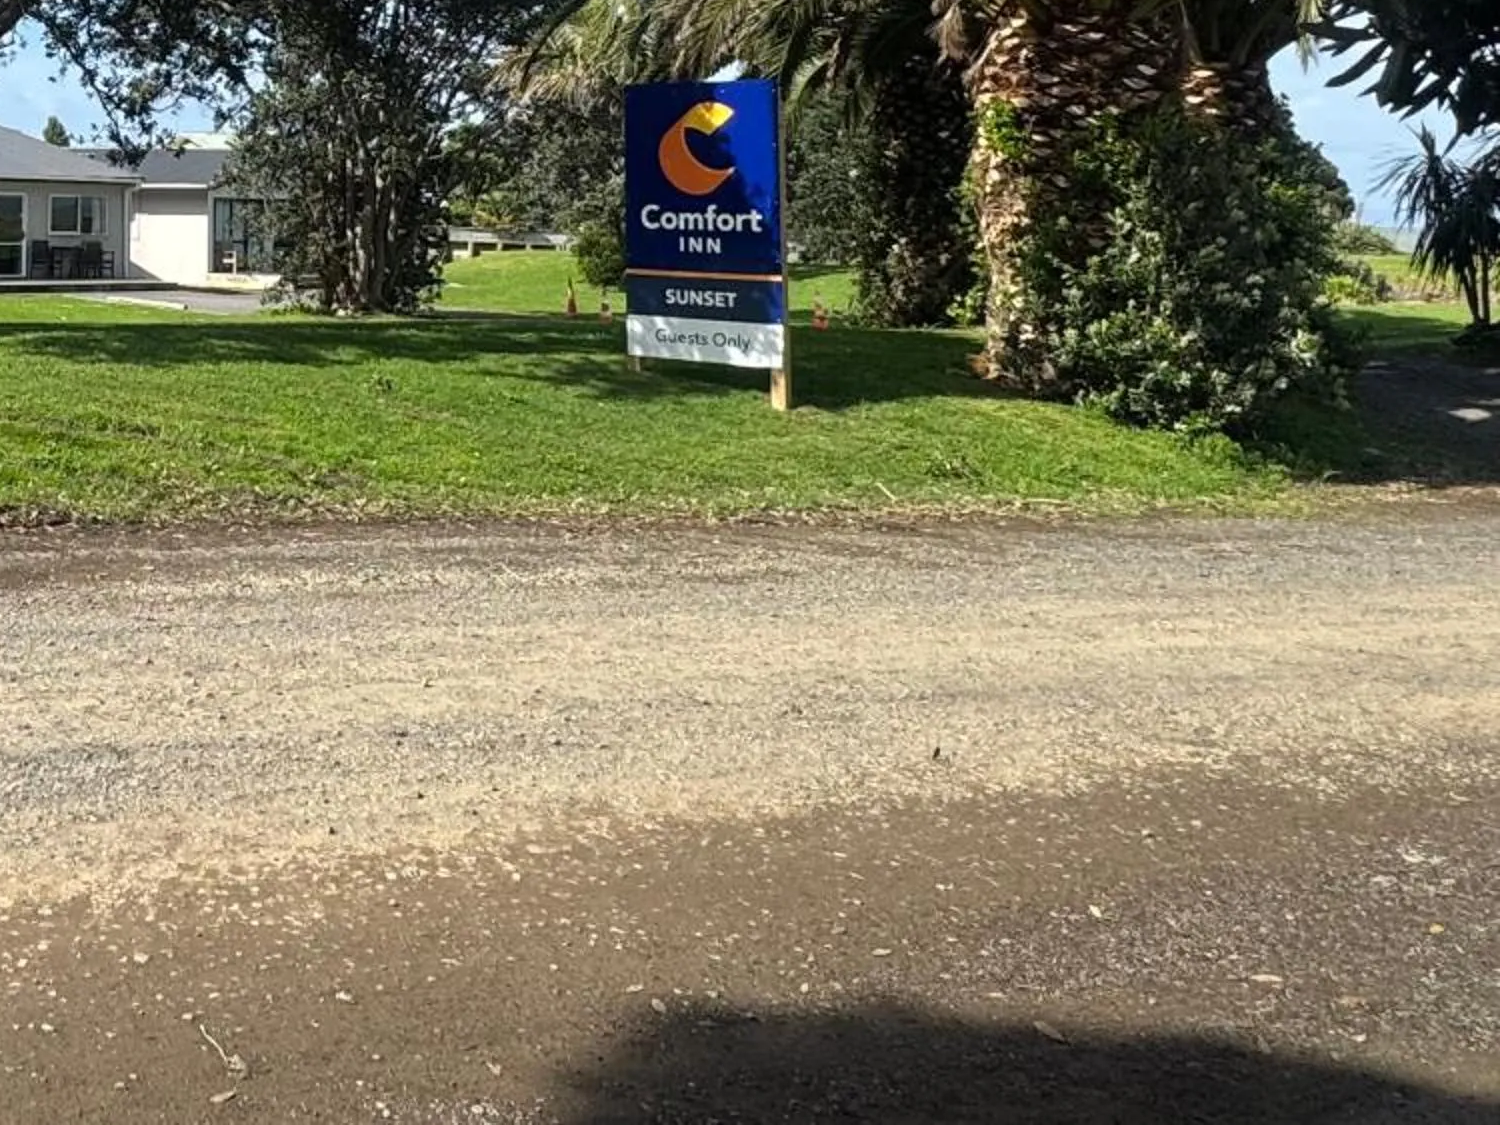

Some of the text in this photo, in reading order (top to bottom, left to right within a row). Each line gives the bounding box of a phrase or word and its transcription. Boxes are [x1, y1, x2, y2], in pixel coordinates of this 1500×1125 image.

[640, 204, 763, 233] Comfort
[679, 236, 722, 254] INN
[665, 288, 737, 307] SUNSET
[655, 329, 750, 350] Guests Only
